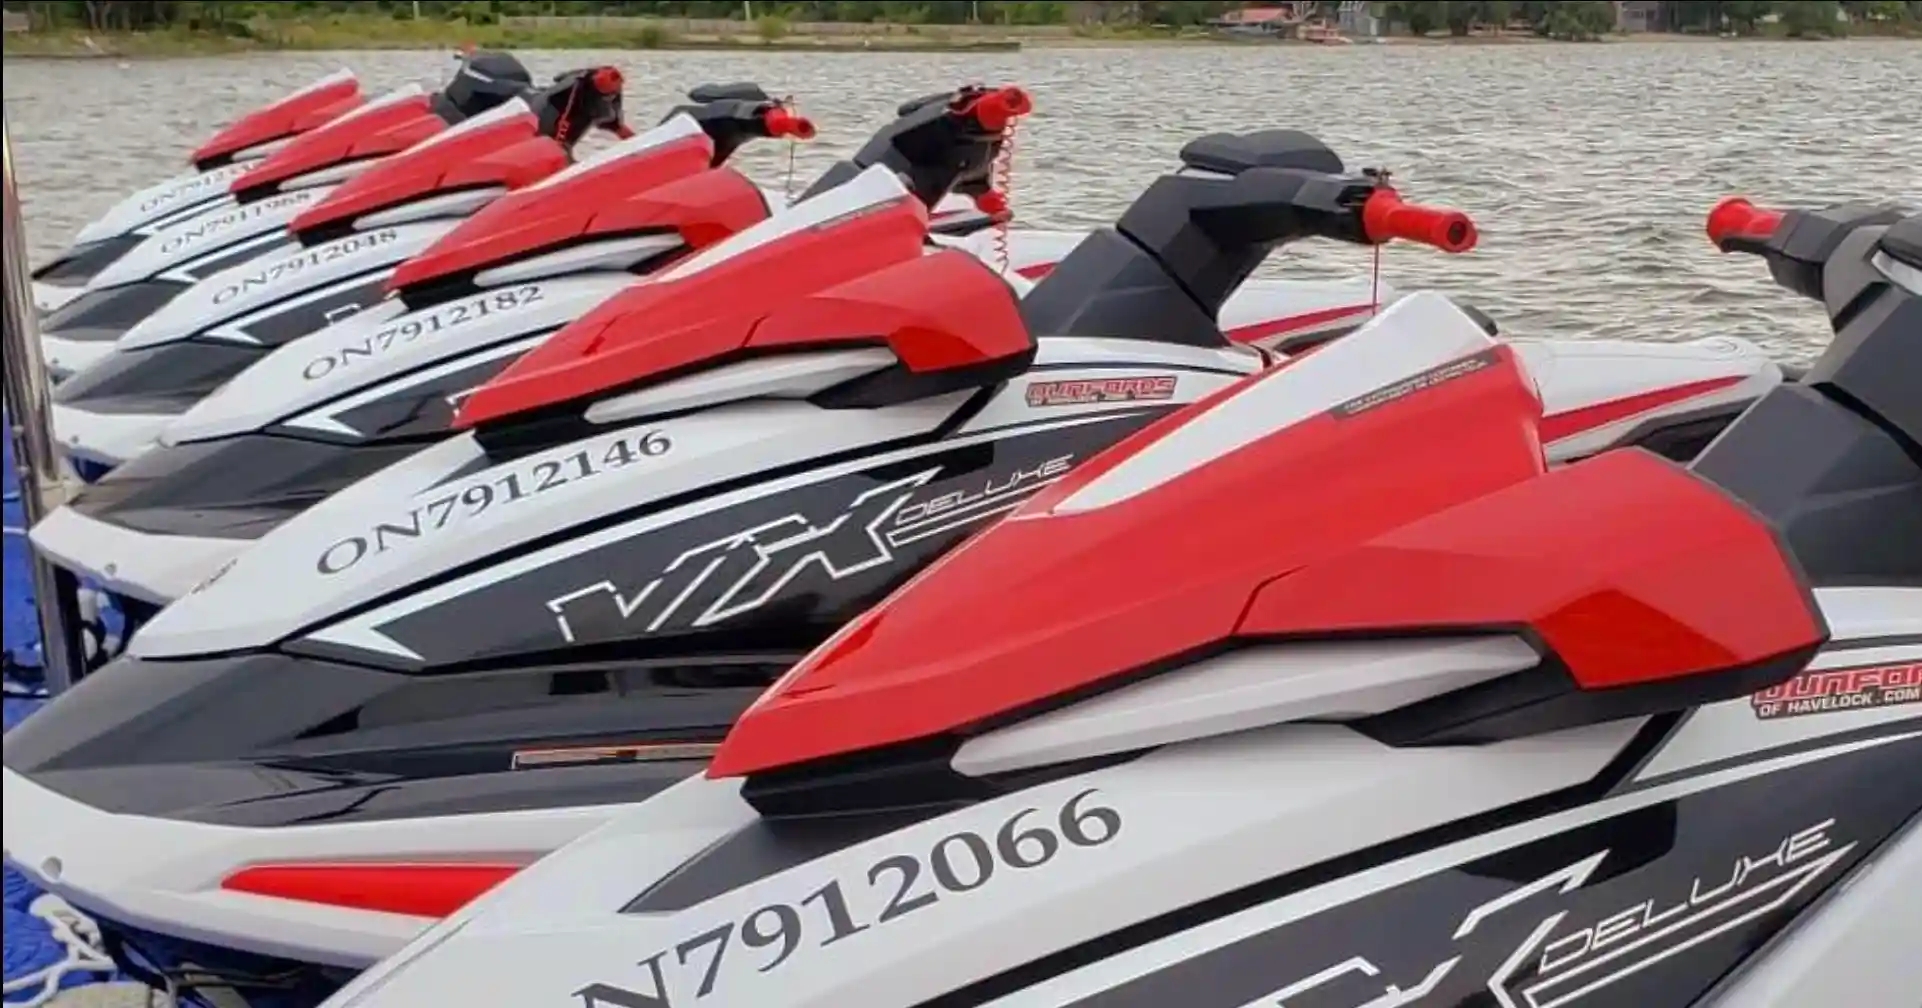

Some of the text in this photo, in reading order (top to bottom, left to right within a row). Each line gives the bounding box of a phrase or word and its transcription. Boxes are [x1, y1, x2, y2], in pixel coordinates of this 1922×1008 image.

[212, 228, 398, 305] ON7912048
[302, 284, 546, 382] ON7912182
[316, 428, 672, 575] ON7912146
[894, 453, 1075, 526] DELUXE
[1759, 704, 1781, 717] OF
[1538, 817, 1837, 975] DELUXE
